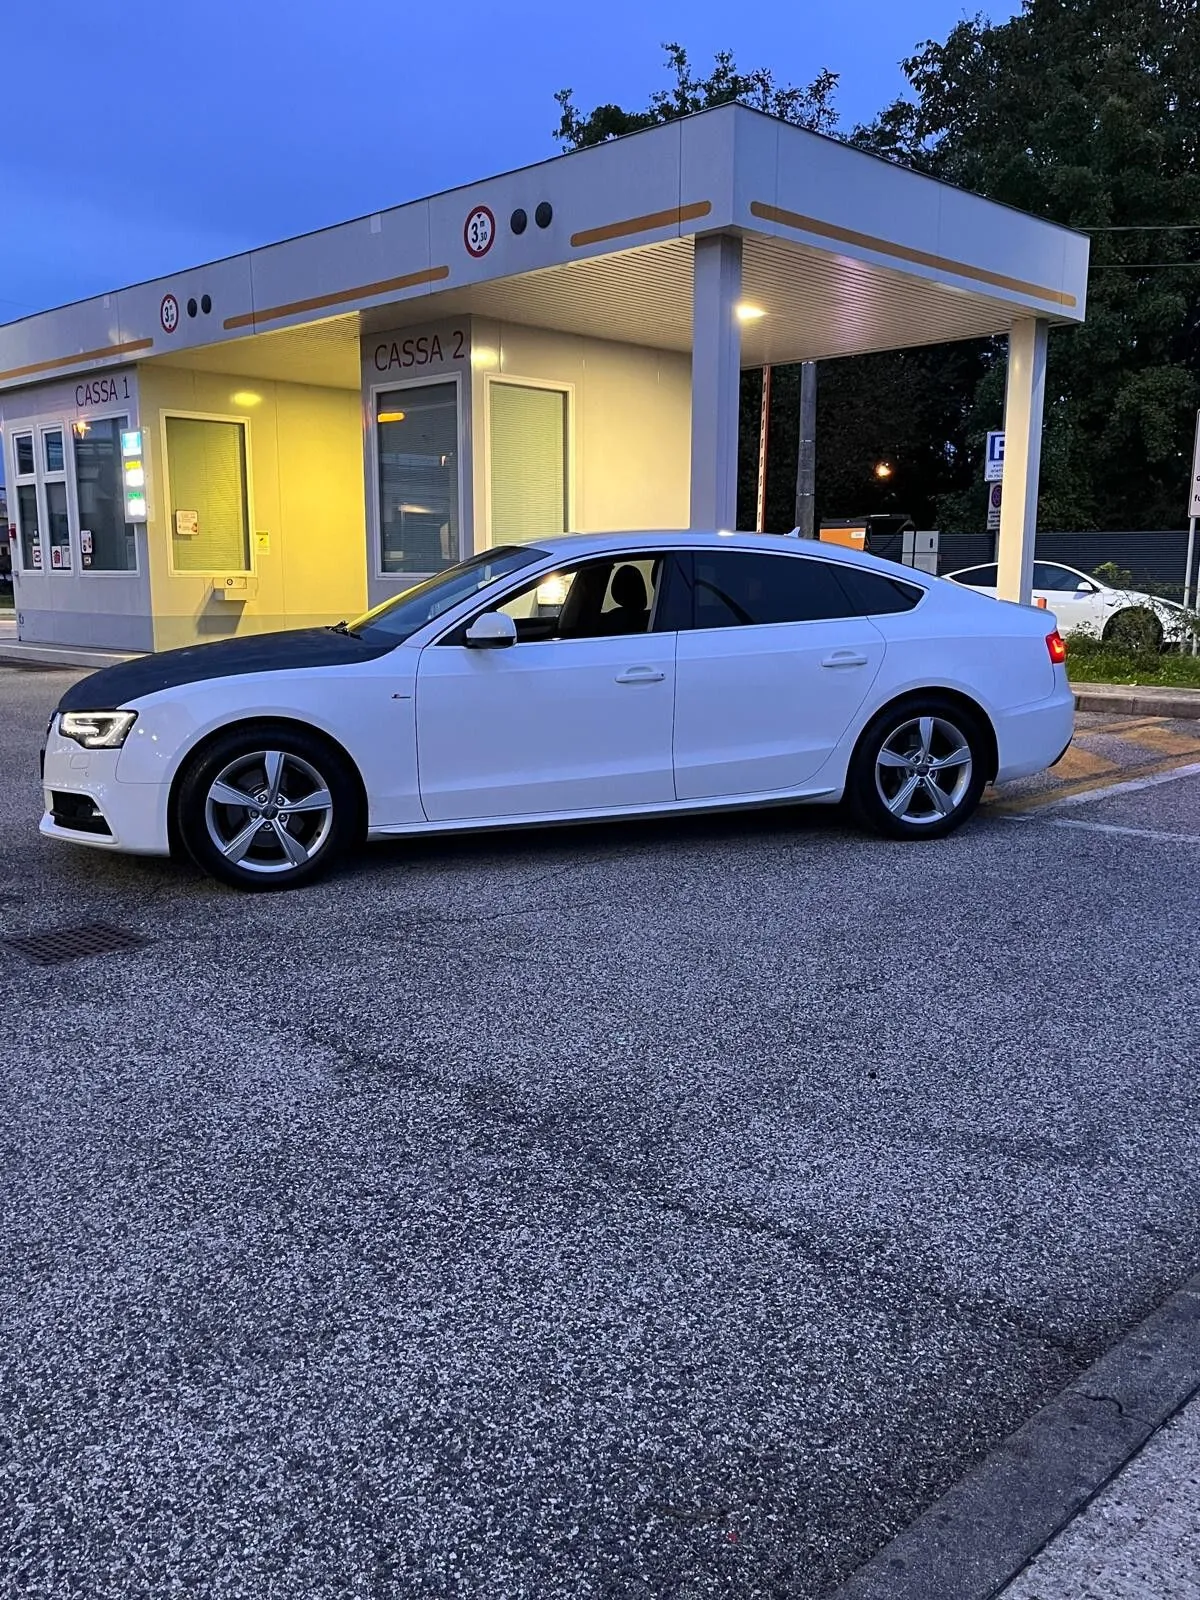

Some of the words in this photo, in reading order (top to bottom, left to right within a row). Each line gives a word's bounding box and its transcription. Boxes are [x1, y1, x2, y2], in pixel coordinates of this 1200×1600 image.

[375, 334, 443, 371] CASSA
[453, 330, 465, 359] 2
[76, 378, 118, 407] CASSA
[123, 375, 130, 399] 1
